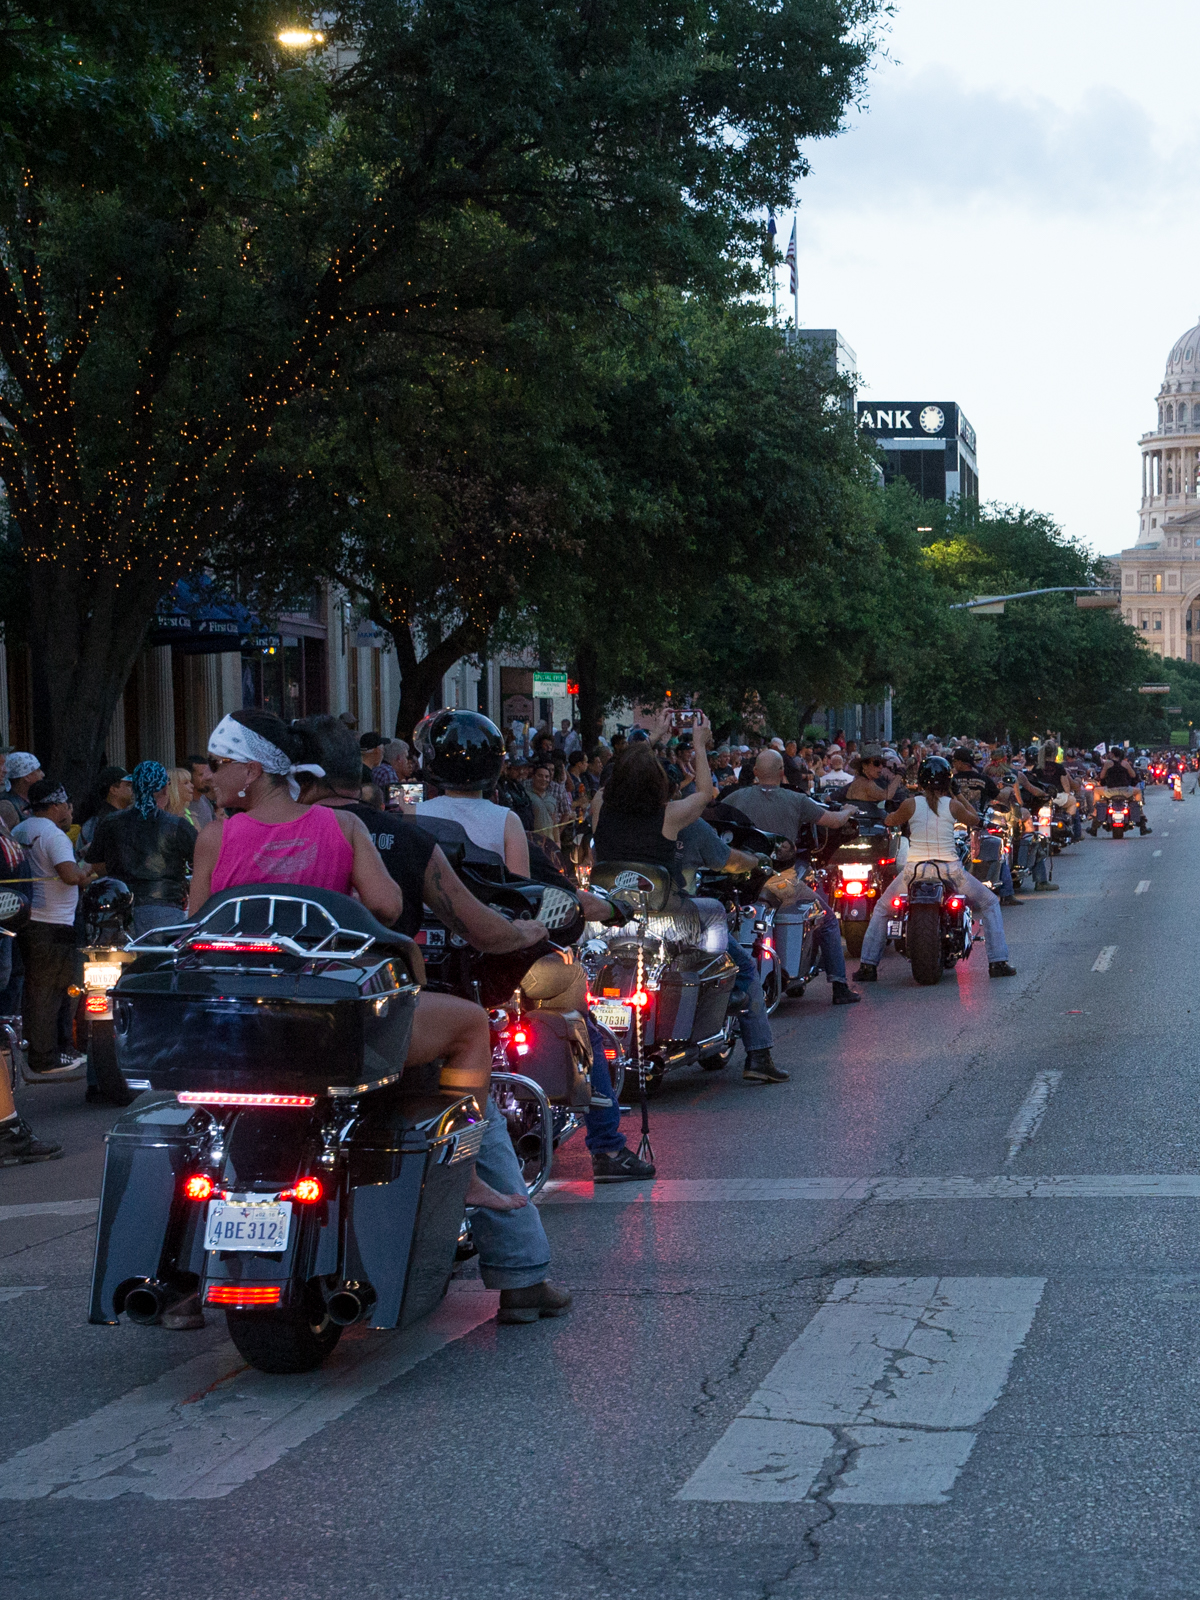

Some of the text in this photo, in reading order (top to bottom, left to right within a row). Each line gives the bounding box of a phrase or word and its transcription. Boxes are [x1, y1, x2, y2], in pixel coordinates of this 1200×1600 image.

[860, 410, 913, 429] ANK
[209, 621, 226, 632] First
[378, 833, 394, 850] OF
[596, 1015, 626, 1026] 37G3H
[214, 1221, 278, 1240] 4BE312
